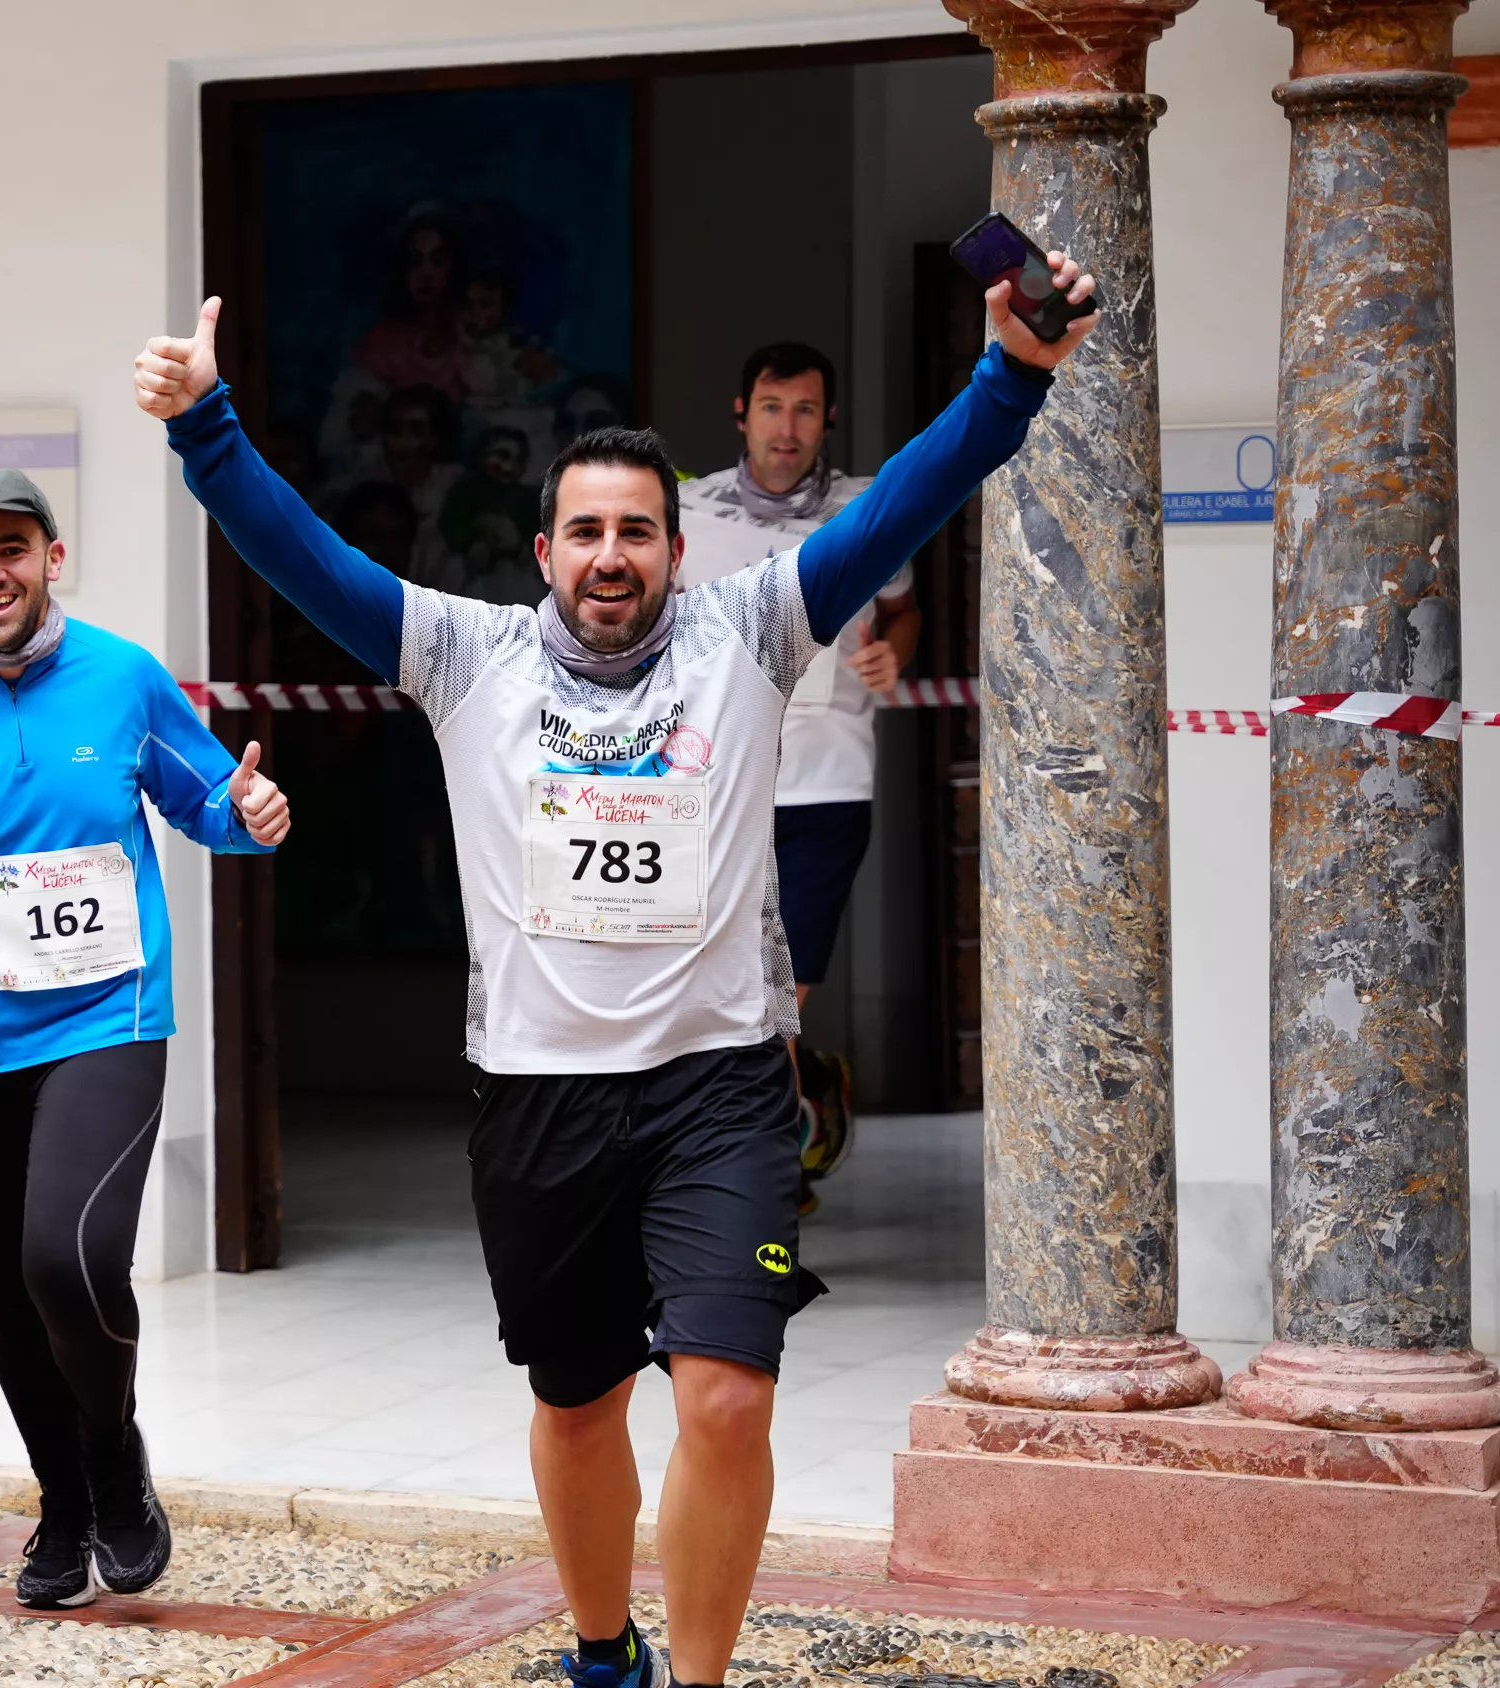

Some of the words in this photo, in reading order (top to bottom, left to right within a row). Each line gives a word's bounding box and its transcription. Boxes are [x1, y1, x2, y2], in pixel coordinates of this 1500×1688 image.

[540, 709, 572, 739] VIII
[568, 731, 618, 748] MEDIA
[538, 733, 599, 761] CIUDAD
[601, 747, 627, 761] DE
[575, 785, 595, 810] X
[595, 805, 653, 825] LUCENA
[24, 860, 39, 880] X
[569, 838, 663, 885] 783
[43, 873, 88, 889] LUCENA
[27, 897, 104, 941] 162
